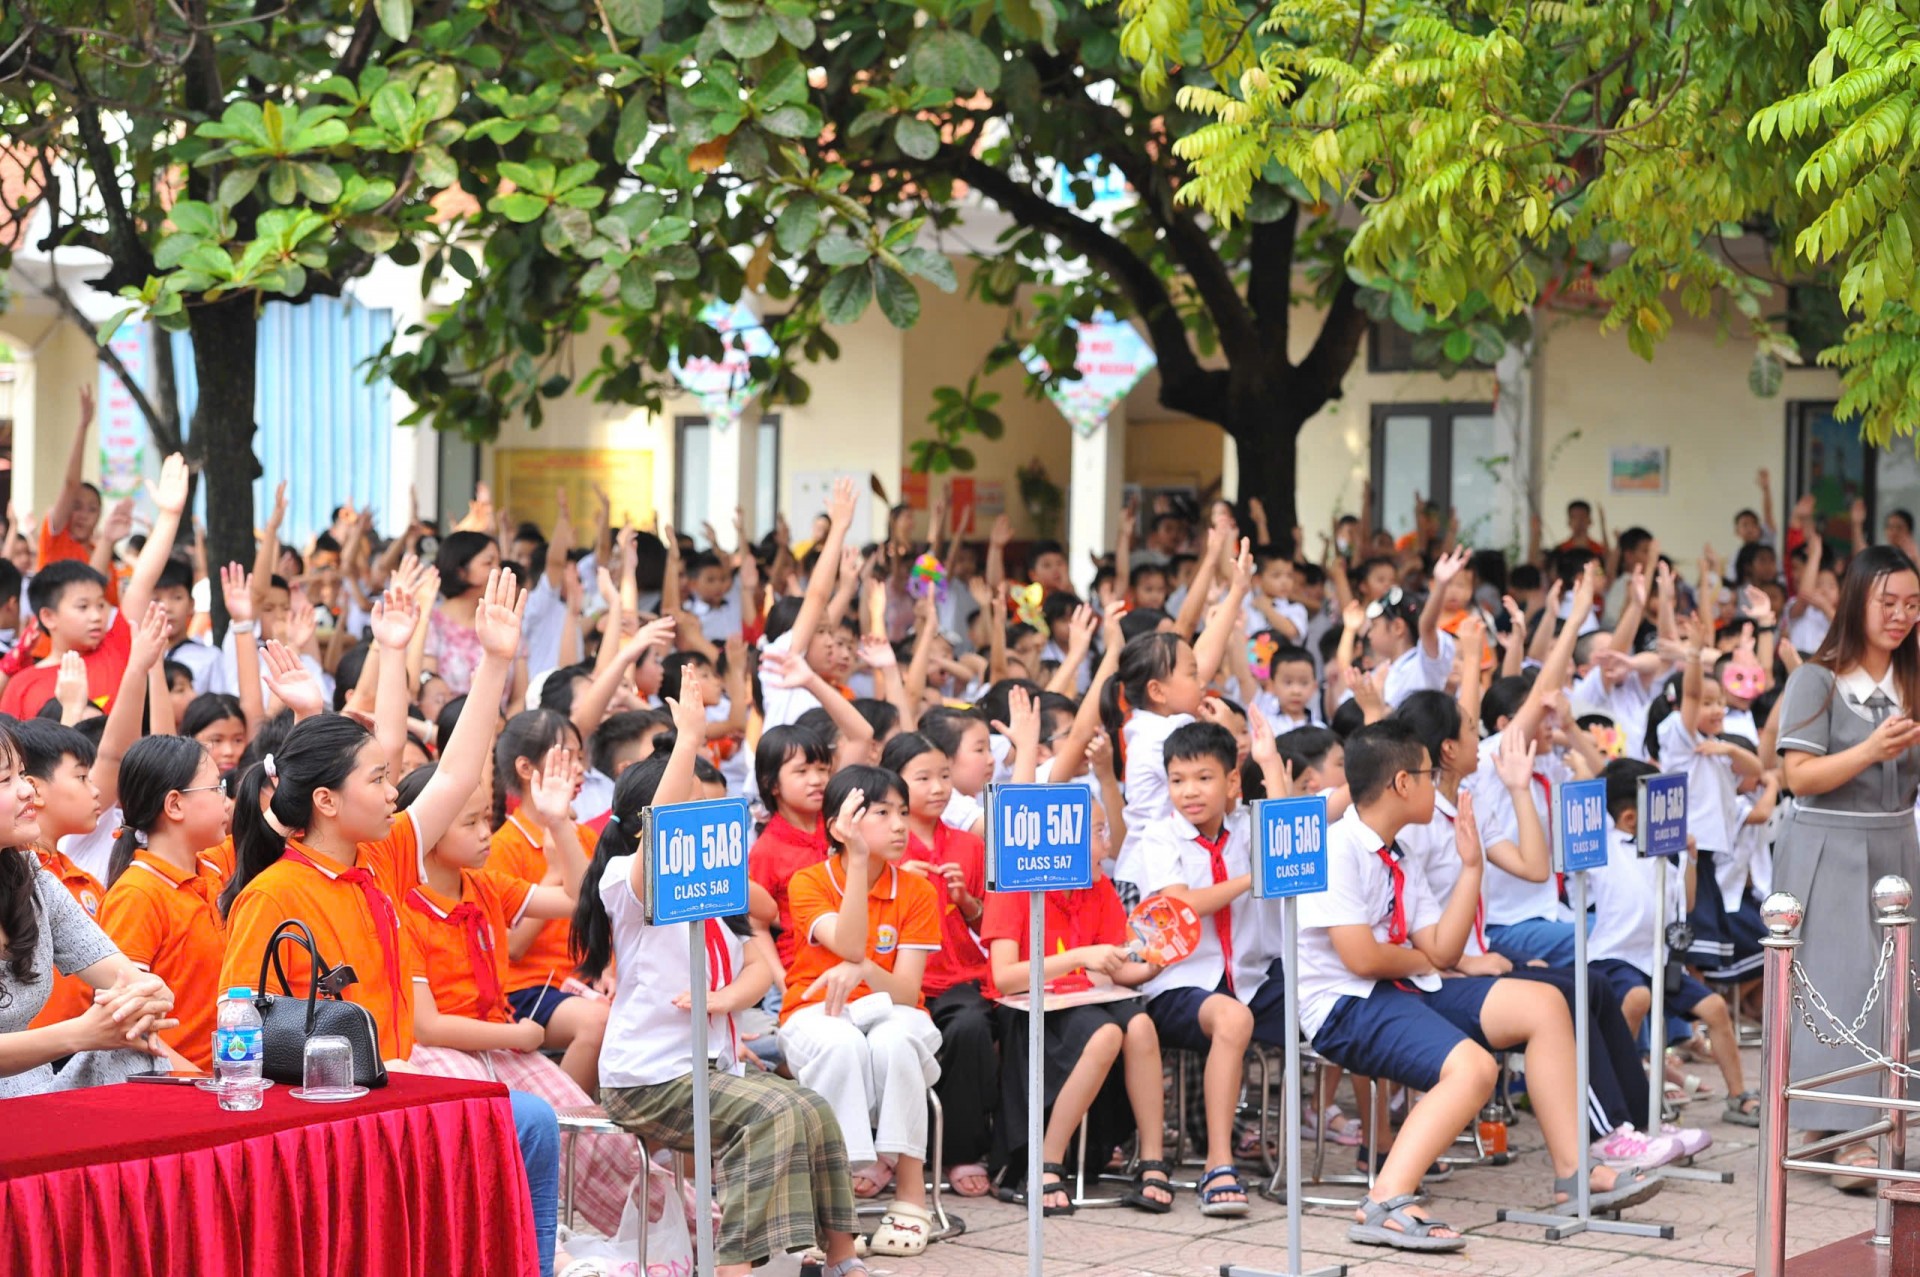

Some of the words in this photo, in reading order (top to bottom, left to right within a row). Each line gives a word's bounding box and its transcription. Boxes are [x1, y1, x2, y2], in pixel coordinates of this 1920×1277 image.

[1567, 798, 1584, 837] Lớp
[1651, 789, 1666, 826] Lớp
[1004, 804, 1041, 851] Lớp
[1046, 803, 1084, 846] 5A7
[1268, 817, 1292, 860] Lớp
[1294, 814, 1321, 854] 5A6
[659, 827, 696, 878] Lớp
[701, 821, 743, 870] 5A8
[1017, 856, 1051, 871] CLASS
[1053, 855, 1072, 869] 5A7
[1276, 864, 1299, 879] CLASS
[1301, 862, 1316, 876] 5A6
[674, 882, 707, 901] CLASS
[710, 879, 730, 896] 5A8
